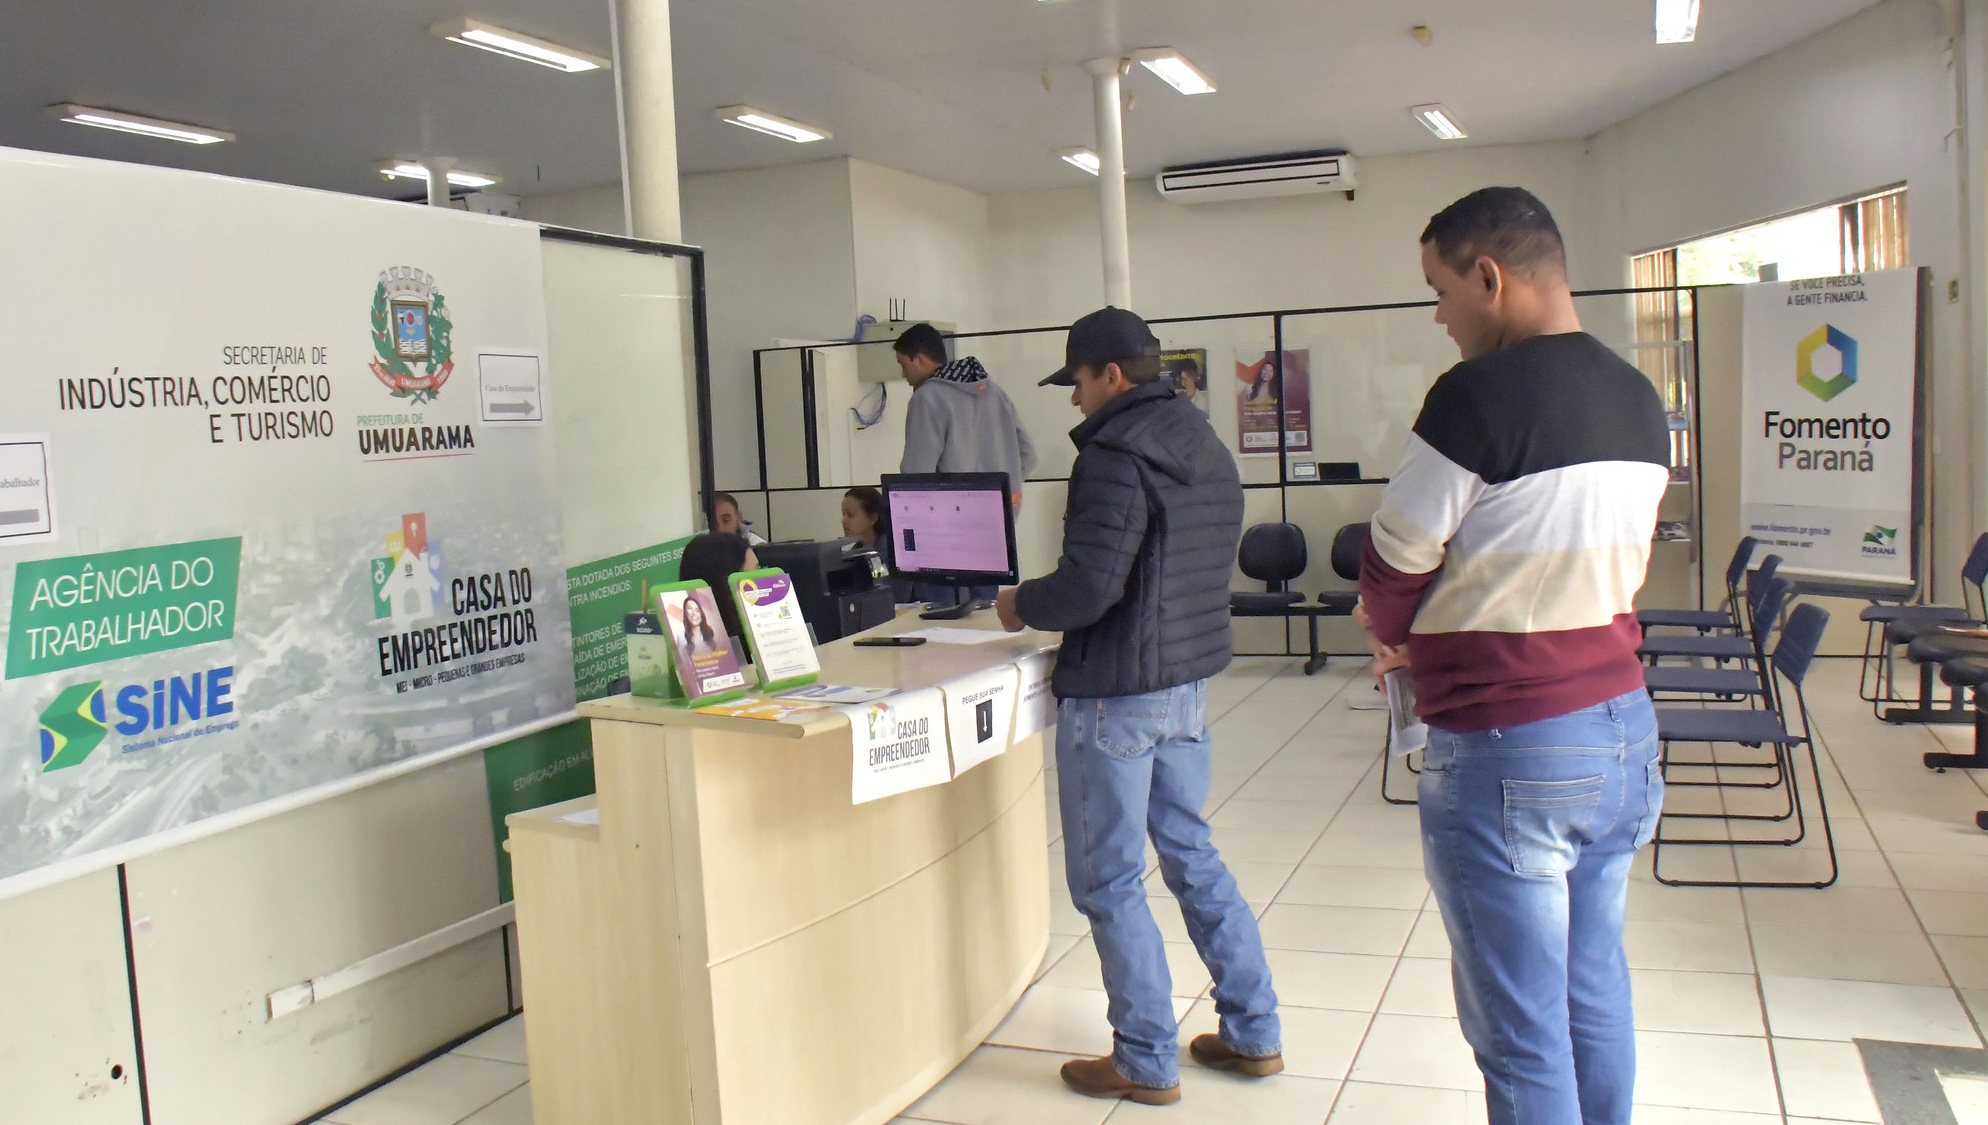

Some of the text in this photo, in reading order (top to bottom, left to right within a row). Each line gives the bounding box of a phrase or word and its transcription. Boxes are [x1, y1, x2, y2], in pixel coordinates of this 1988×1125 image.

[1787, 291, 1868, 306] A GENTE FINANCIA.
[223, 346, 328, 365] SECRETARIA DE
[59, 366, 331, 410] INDÚSTRIA, COMÉRCIO
[209, 410, 334, 443] E TURISMO
[357, 413, 424, 427] PREFEITURA DE
[1764, 411, 1890, 439] Fomento
[358, 425, 475, 455] UMUARAMA
[1778, 441, 1874, 472] Paraná
[30, 557, 214, 611] AGÊNCIA DO
[582, 568, 614, 587] DOTADA
[614, 562, 631, 577] DOS
[631, 551, 672, 572] SEGUINTES
[451, 567, 532, 616] CASA DO
[27, 600, 225, 660] TRABALHADOR
[378, 608, 537, 677] EMPREENDEDOR
[611, 622, 622, 636] DE
[593, 645, 604, 658] DE
[608, 655, 619, 669] DE
[396, 681, 408, 694] MEI
[438, 667, 465, 684] PEQUENAS
[471, 659, 495, 675] GRANDES
[496, 652, 525, 669] EMPRESAS
[962, 685, 1004, 705] PEGUE SUA SENHA
[122, 720, 239, 754] Sistema Nacional de Emprego
[897, 717, 929, 740] CASA DO
[869, 736, 930, 766] EMPREENDEDOR
[512, 760, 566, 792] EDIFICAÇÃO
